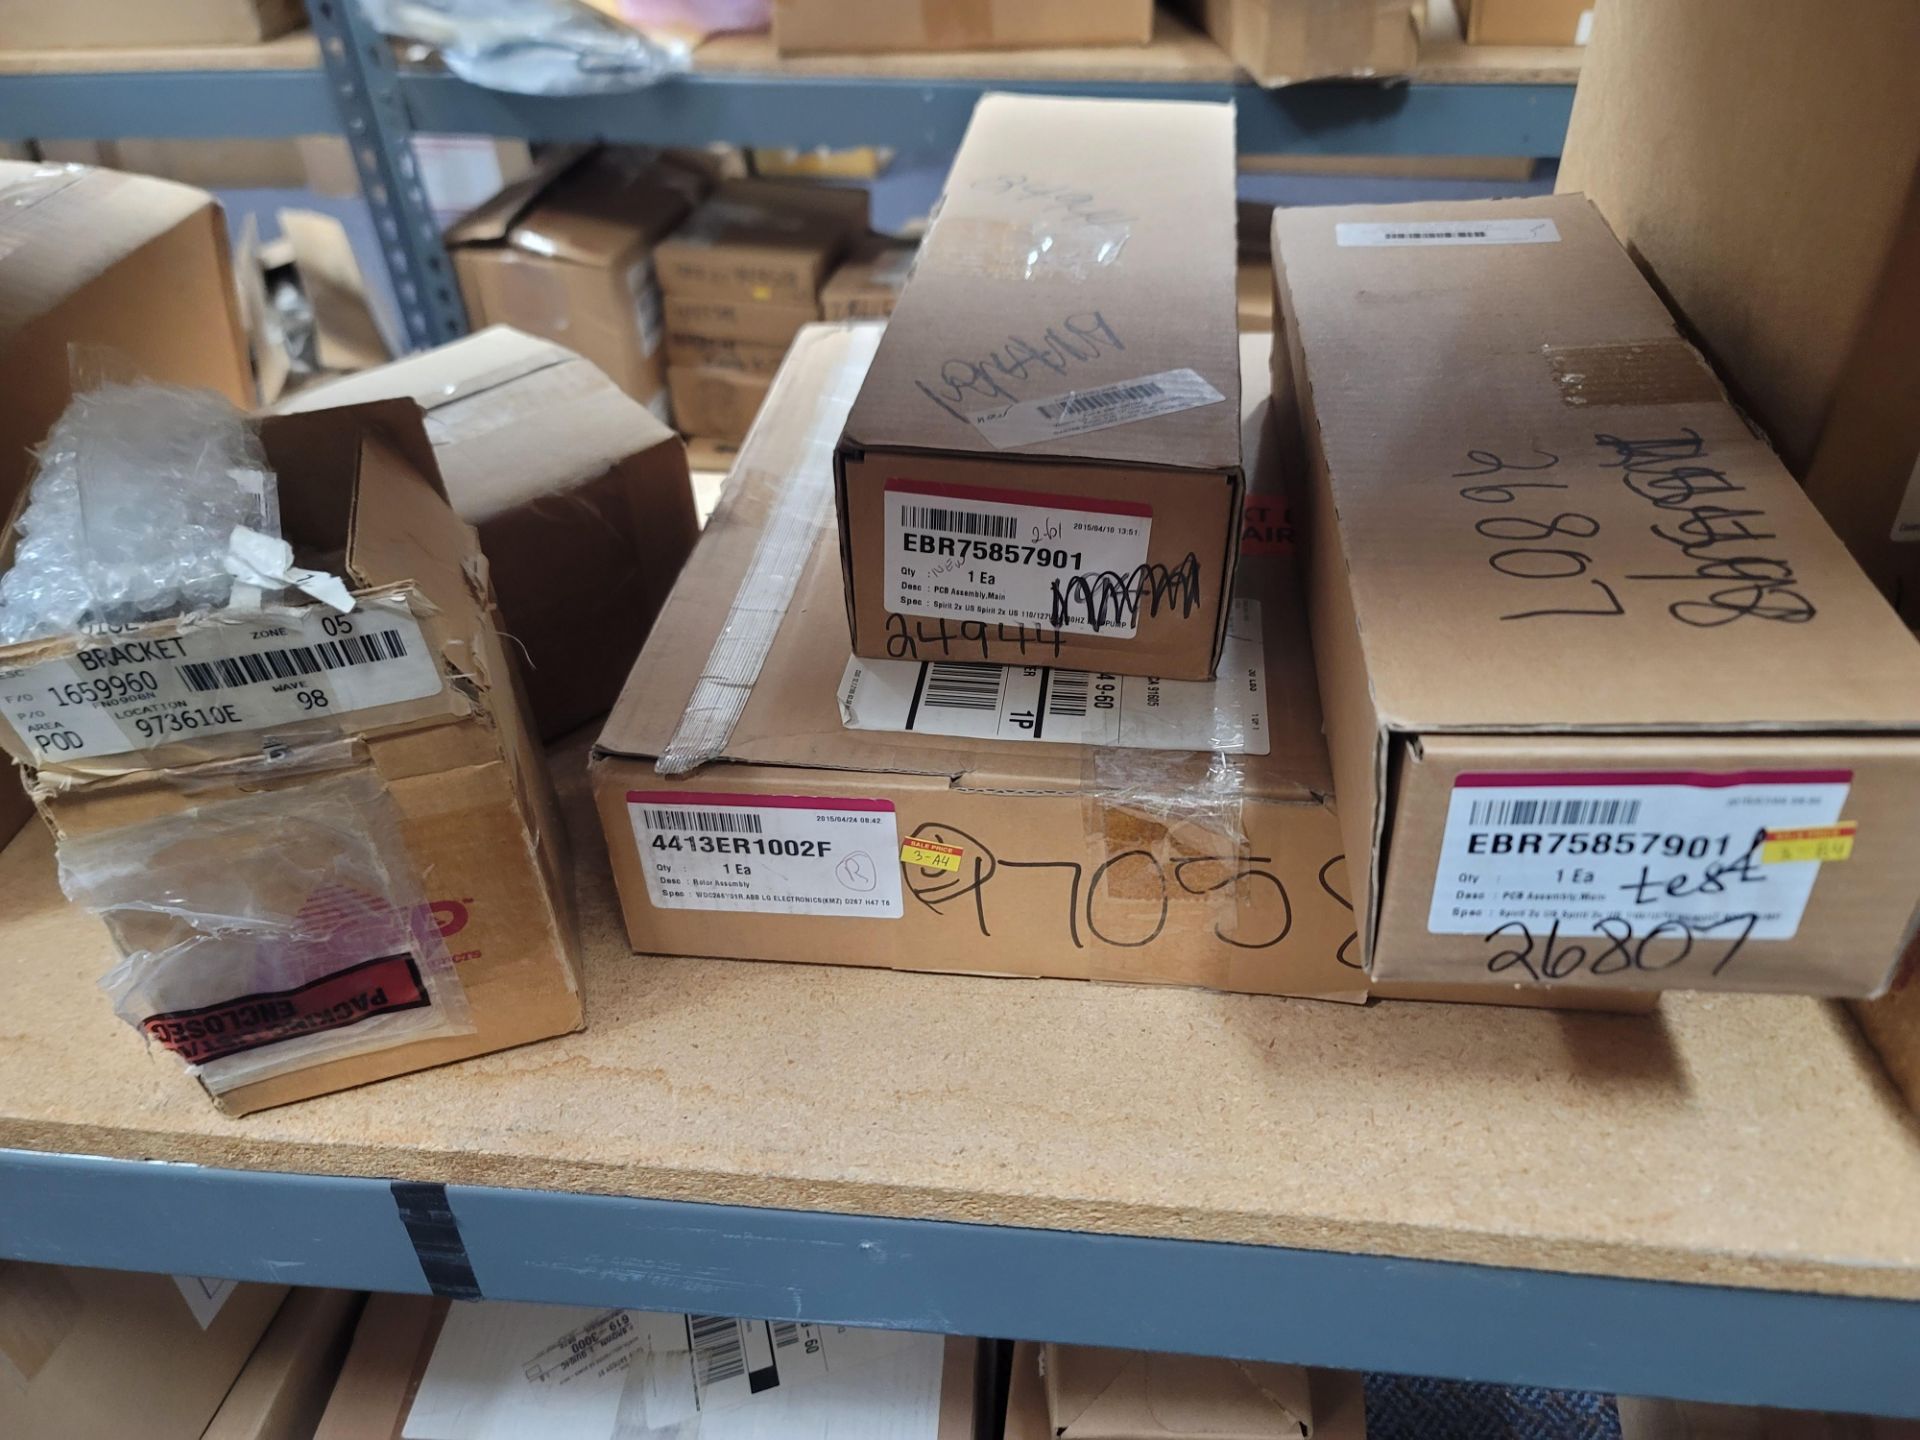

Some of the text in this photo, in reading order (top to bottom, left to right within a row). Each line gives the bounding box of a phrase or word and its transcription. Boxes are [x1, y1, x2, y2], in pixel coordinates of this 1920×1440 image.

[1451, 449, 1626, 621] 26807
[903, 532, 1082, 571] EBR75857901
[901, 566, 996, 585] Qty 1 Ea
[901, 581, 922, 592] Desc
[934, 586, 949, 595] PCB
[900, 595, 922, 606] Spec
[77, 613, 354, 671] BRACKET ZONE 05
[886, 612, 1068, 658] 24944
[48, 670, 158, 707] 1659960
[271, 681, 309, 693] WAVE
[114, 700, 188, 720] LOCATION
[297, 689, 329, 710] 98
[28, 721, 65, 733] AREA
[35, 704, 243, 754] POD 973610E
[1009, 710, 1035, 729] 1P
[652, 835, 833, 857] 4413ER1002F
[1468, 832, 1731, 861] EBR75857901
[656, 863, 751, 875] Qty 1 Ea
[1458, 868, 1595, 884] Qty 1 Ea
[1620, 826, 1767, 905] test
[660, 876, 681, 885] Desc
[662, 889, 684, 898] Spec
[1483, 912, 1759, 982] 26807
[608, 1313, 630, 1332] 619
[571, 1331, 600, 1354] 3000
